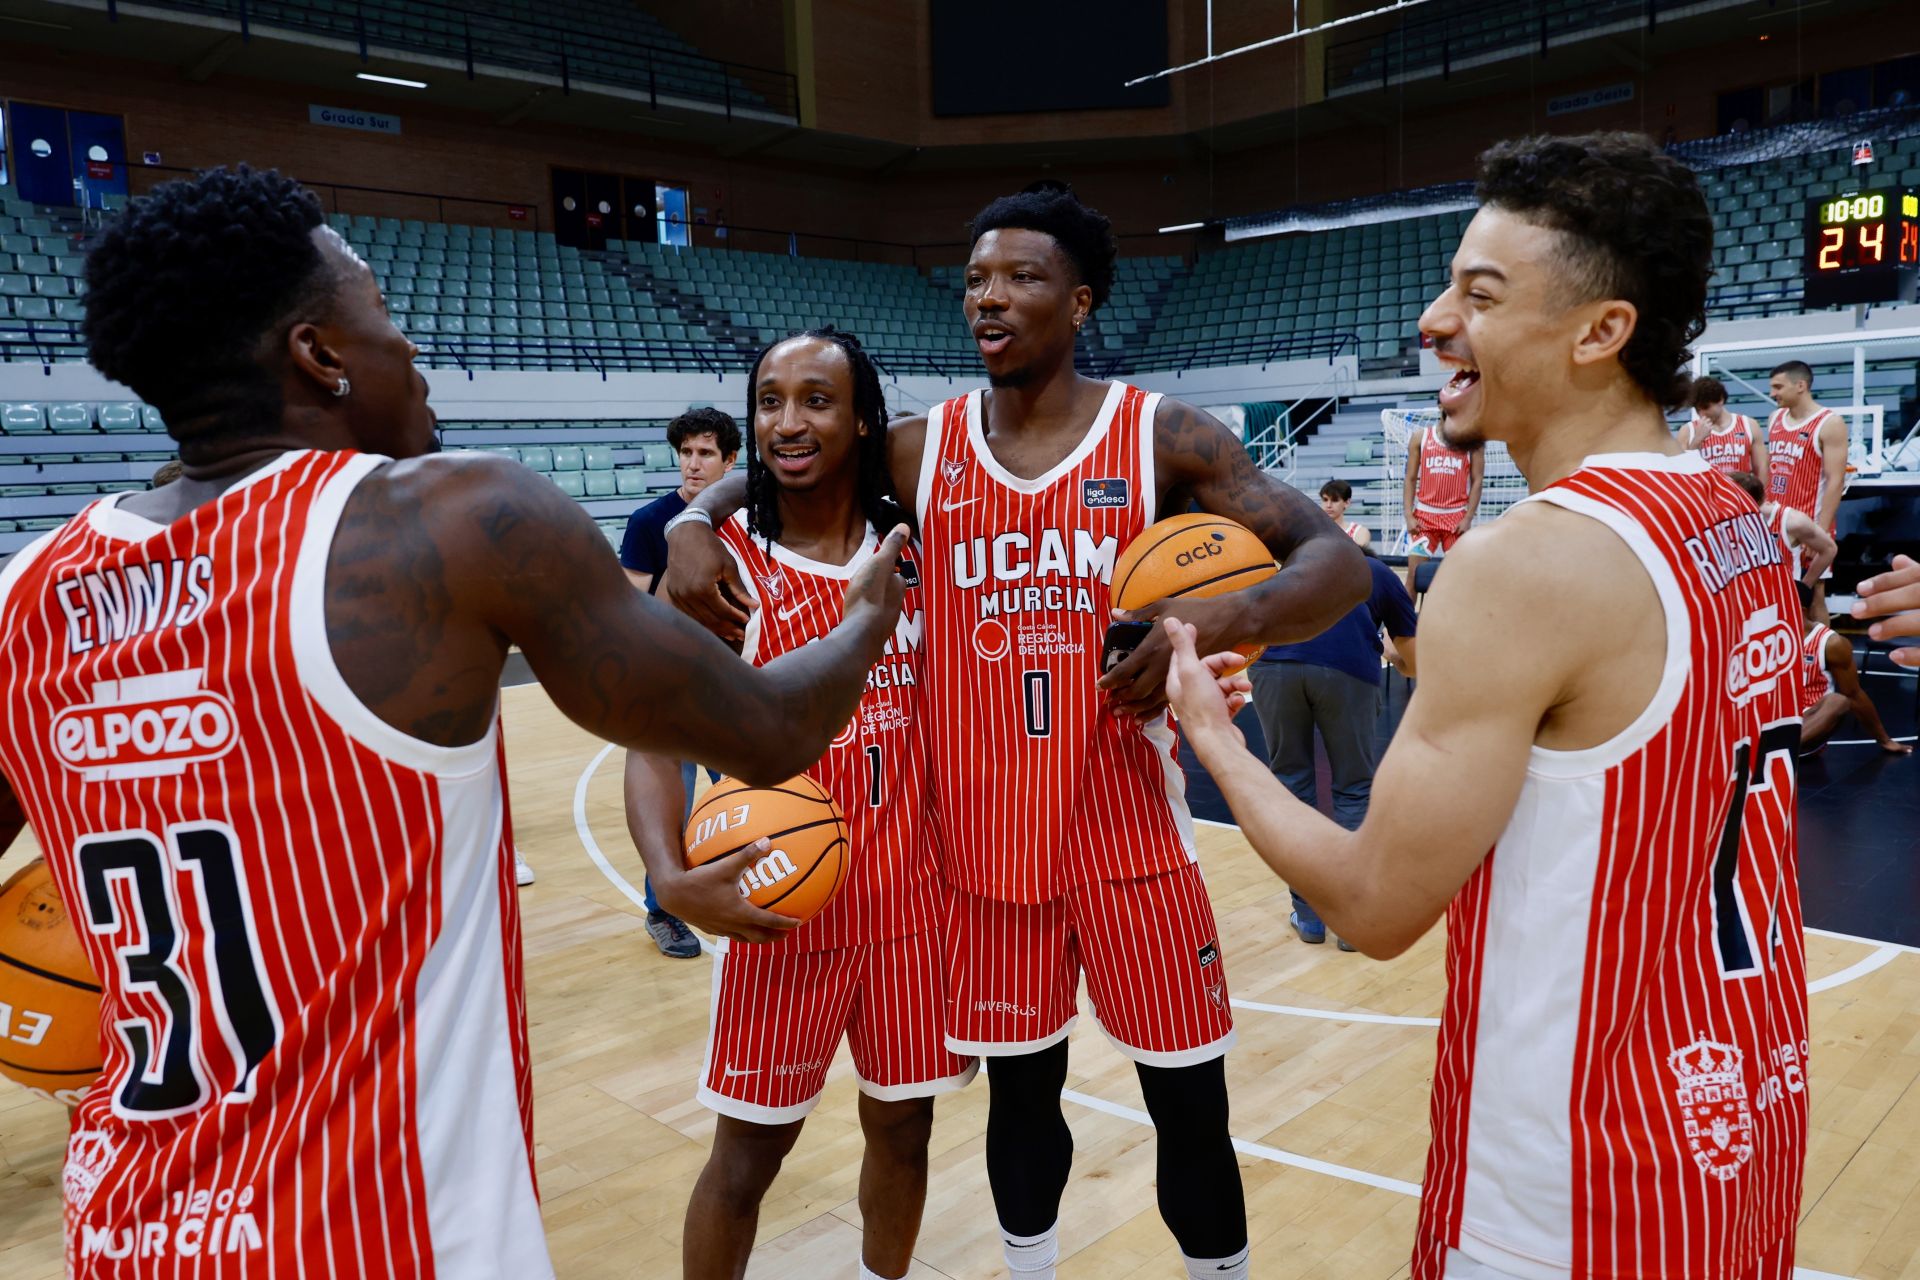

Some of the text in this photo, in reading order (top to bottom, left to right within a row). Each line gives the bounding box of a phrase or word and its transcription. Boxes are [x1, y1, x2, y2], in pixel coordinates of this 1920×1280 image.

[321, 110, 389, 129] Grada Sur
[1827, 195, 1884, 223] 10:00
[1701, 443, 1746, 459] UCAM
[1768, 440, 1805, 460] UCAM
[1425, 455, 1463, 470] UCAM
[1087, 488, 1105, 498] liga
[1087, 496, 1125, 504] endesa
[953, 528, 1119, 590] UCAM
[1175, 541, 1223, 567] acb
[55, 554, 212, 655] ENNIS
[979, 585, 1096, 619] MURCIA
[1017, 623, 1035, 631] Costa
[1017, 630, 1066, 644] REGIÓN
[1018, 643, 1085, 656] DE MURCIA
[1021, 669, 1052, 738] 0
[861, 722, 877, 736] DE
[865, 744, 882, 807] 1
[1201, 950, 1216, 965] acb
[73, 818, 284, 1122] 31
[974, 1000, 1037, 1017] INVERSUS
[774, 1059, 823, 1076] INVERSUS
[172, 1185, 255, 1216] 1200
[80, 1212, 263, 1260] MURCIA
